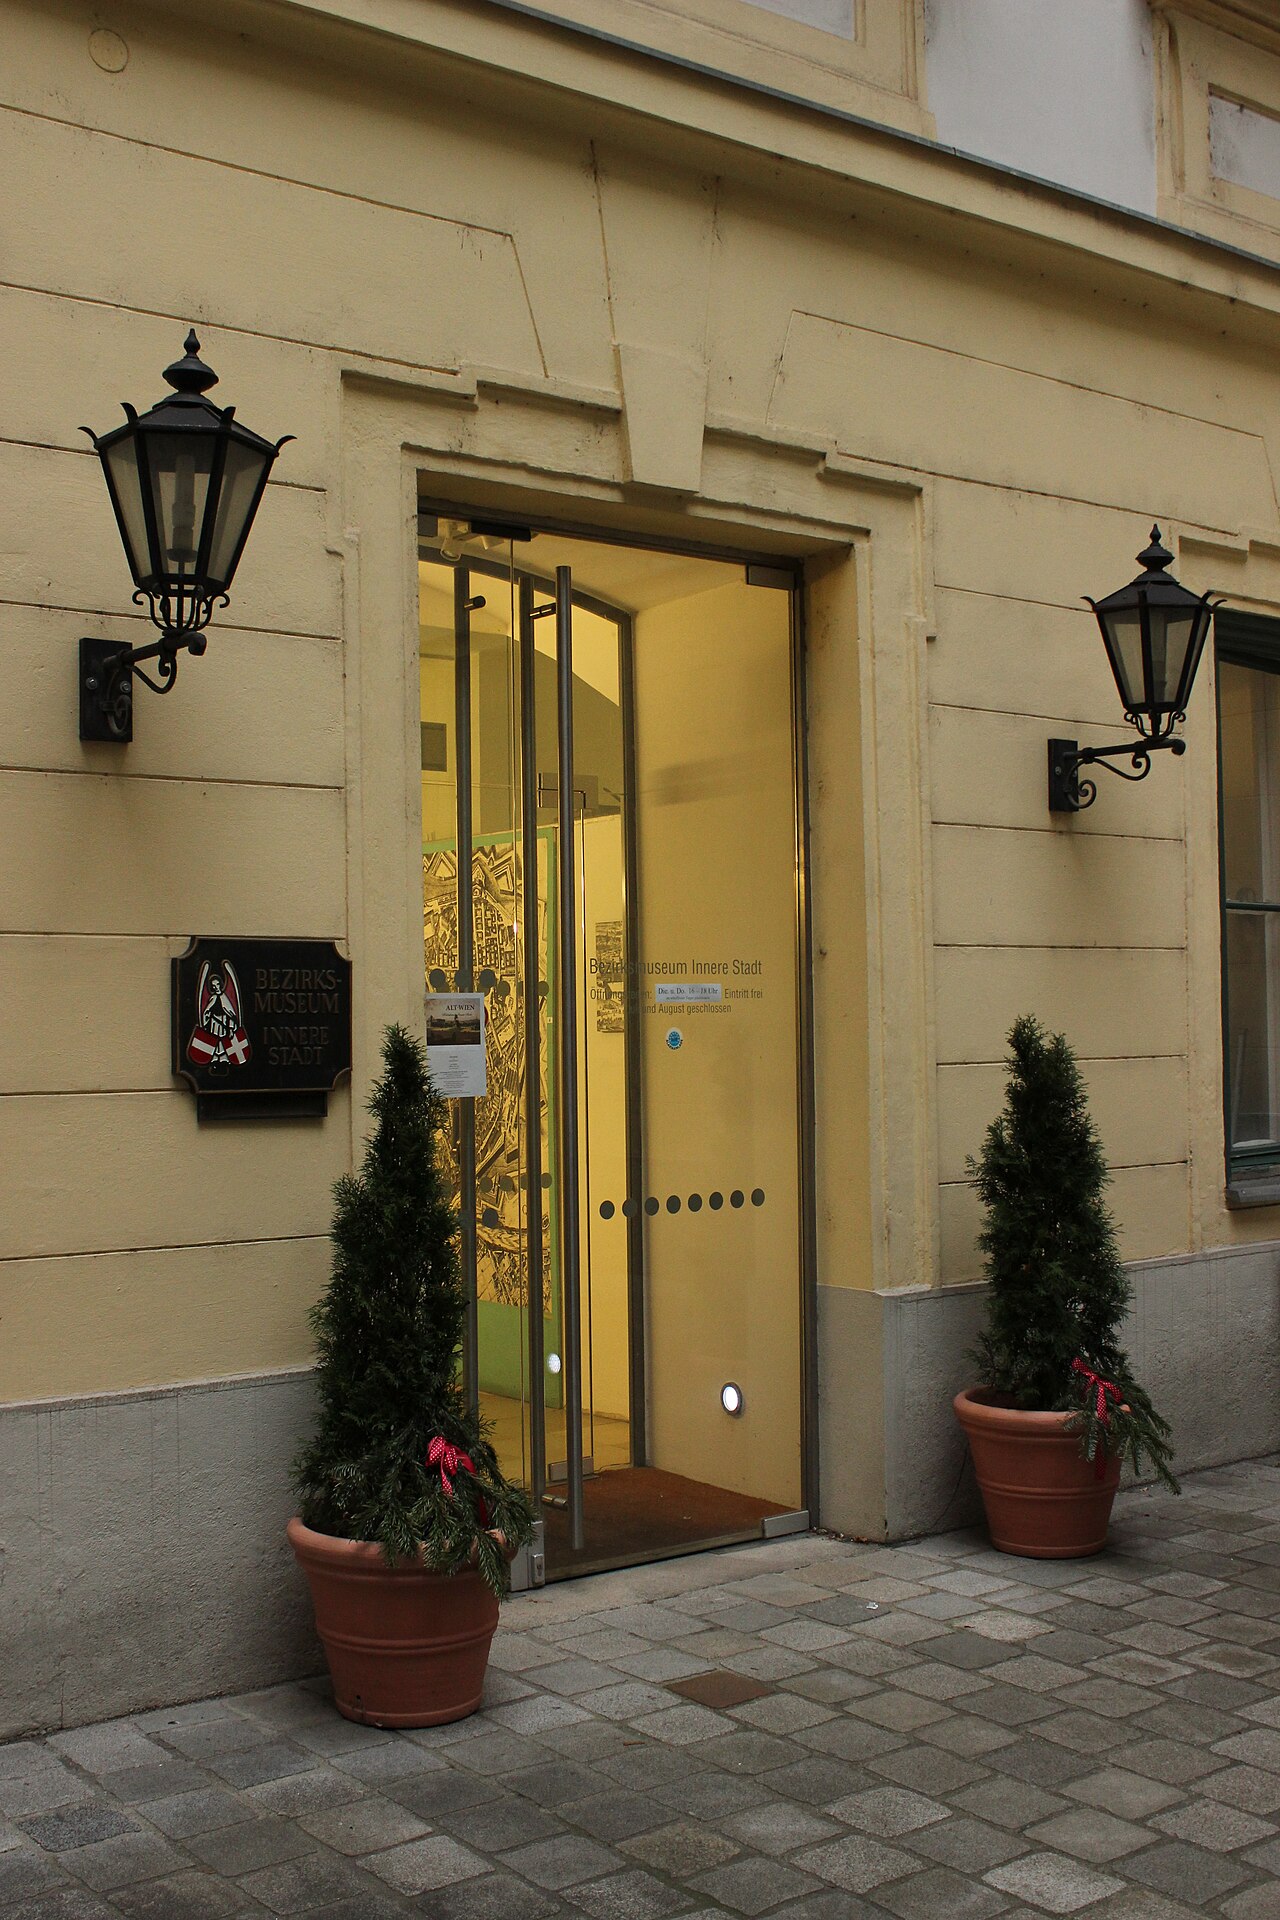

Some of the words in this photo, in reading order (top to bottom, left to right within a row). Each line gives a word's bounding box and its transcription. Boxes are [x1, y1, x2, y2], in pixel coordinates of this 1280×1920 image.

[589, 957, 688, 975] Bezirksmuseum
[692, 959, 729, 975] Innere
[732, 959, 762, 975] Stadt
[255, 968, 342, 990] BEZIRKS-
[589, 985, 653, 1001] Öffnungsein:
[707, 987, 719, 995] Uhr
[724, 988, 749, 999] Eintritt
[750, 988, 763, 999] frei
[253, 992, 340, 1014] MUSEUM
[658, 1003, 685, 1016] August
[686, 1003, 732, 1016] geschlossen
[263, 1026, 329, 1045] INNERE
[268, 1046, 323, 1065] STADT
